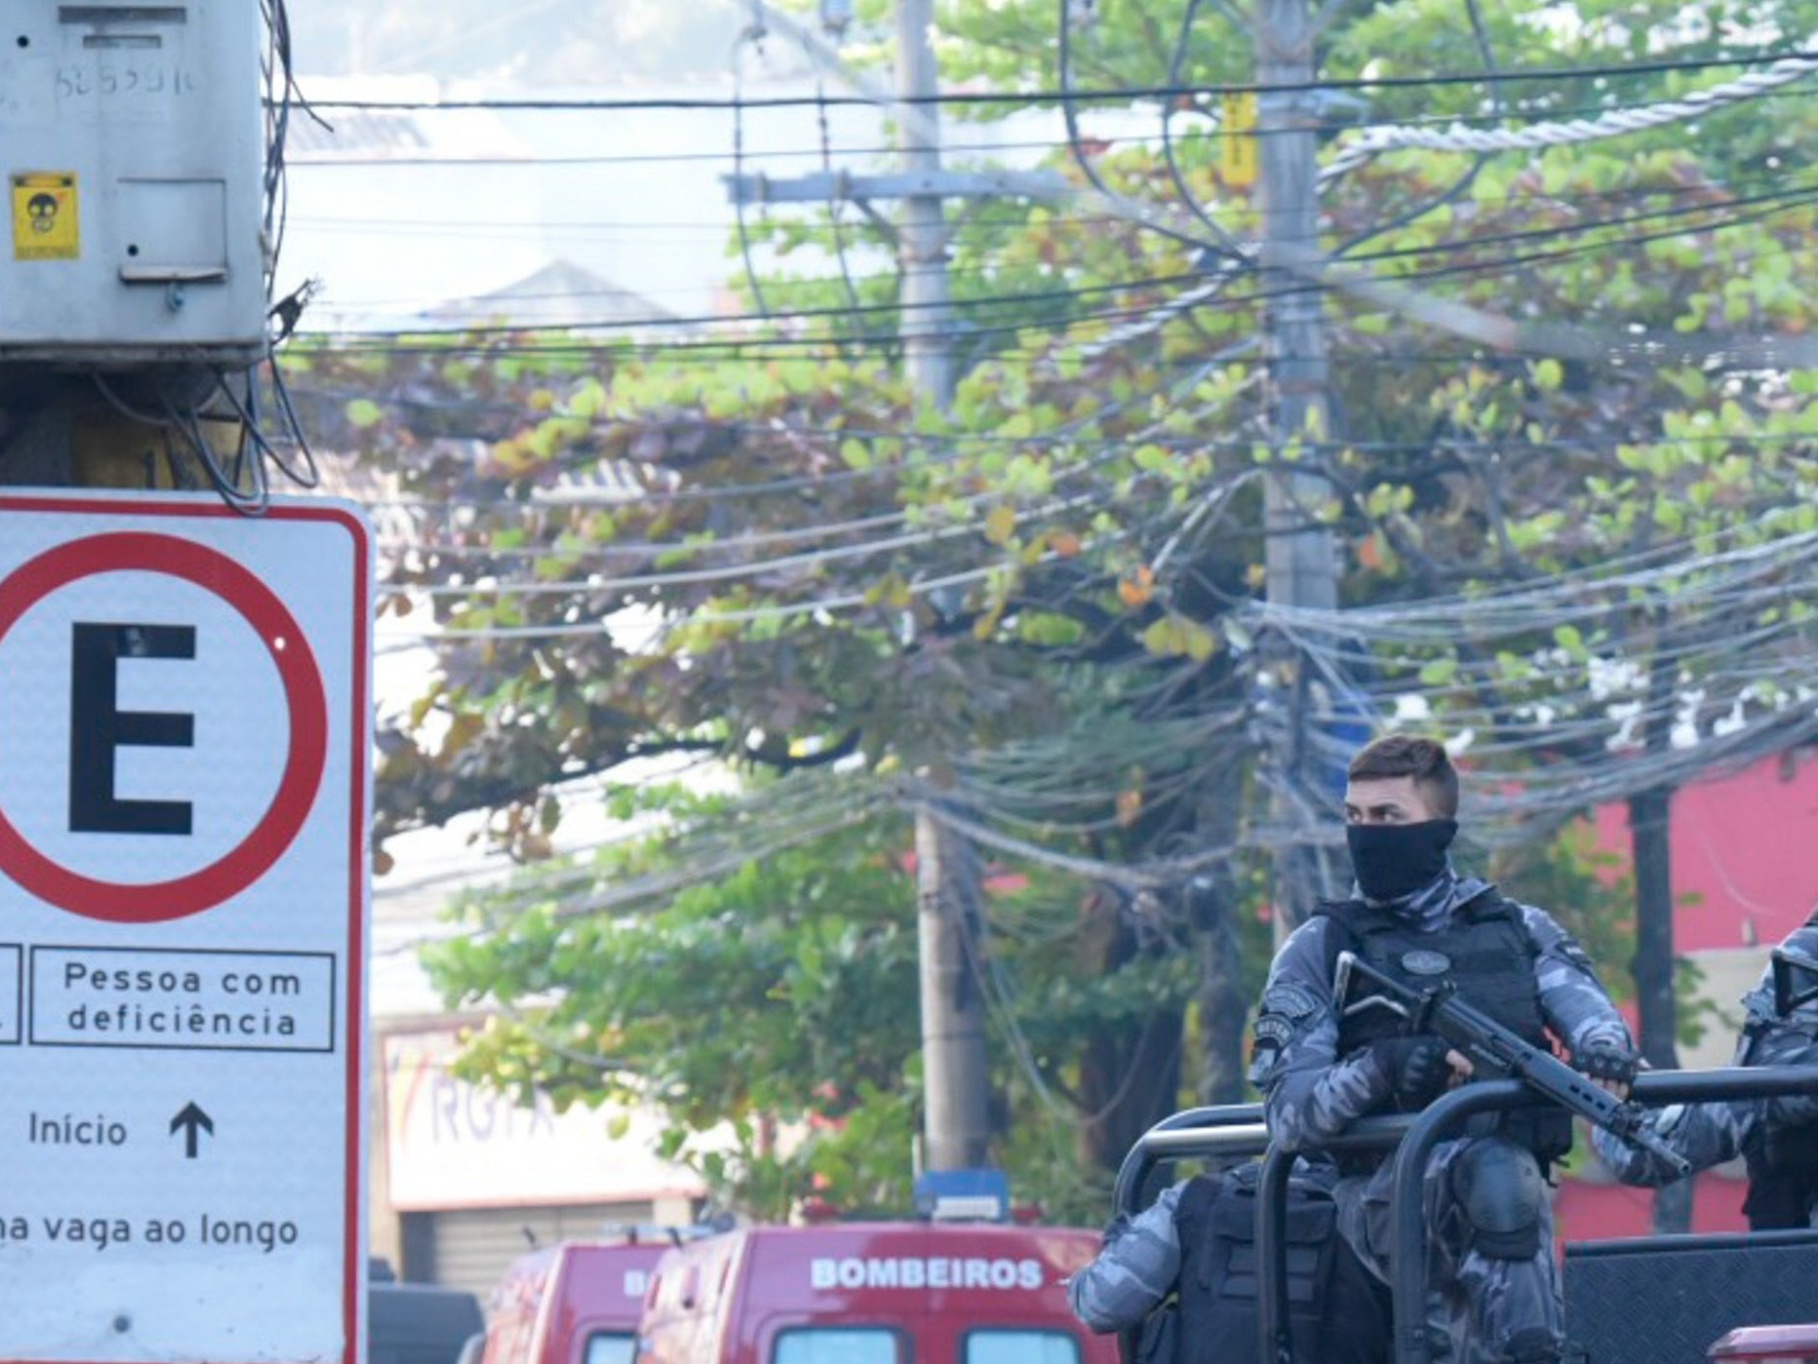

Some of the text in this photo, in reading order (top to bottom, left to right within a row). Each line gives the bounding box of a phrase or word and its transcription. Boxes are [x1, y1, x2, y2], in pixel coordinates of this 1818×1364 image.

[69, 622, 197, 835] E
[64, 962, 300, 996] Pessoa com
[68, 1004, 296, 1037] deficiência
[28, 1112, 127, 1146] Início
[43, 1217, 131, 1253] vaga
[145, 1220, 186, 1244] ao
[200, 1214, 298, 1254] longo
[811, 1258, 1043, 1290] BOMBEIROS
